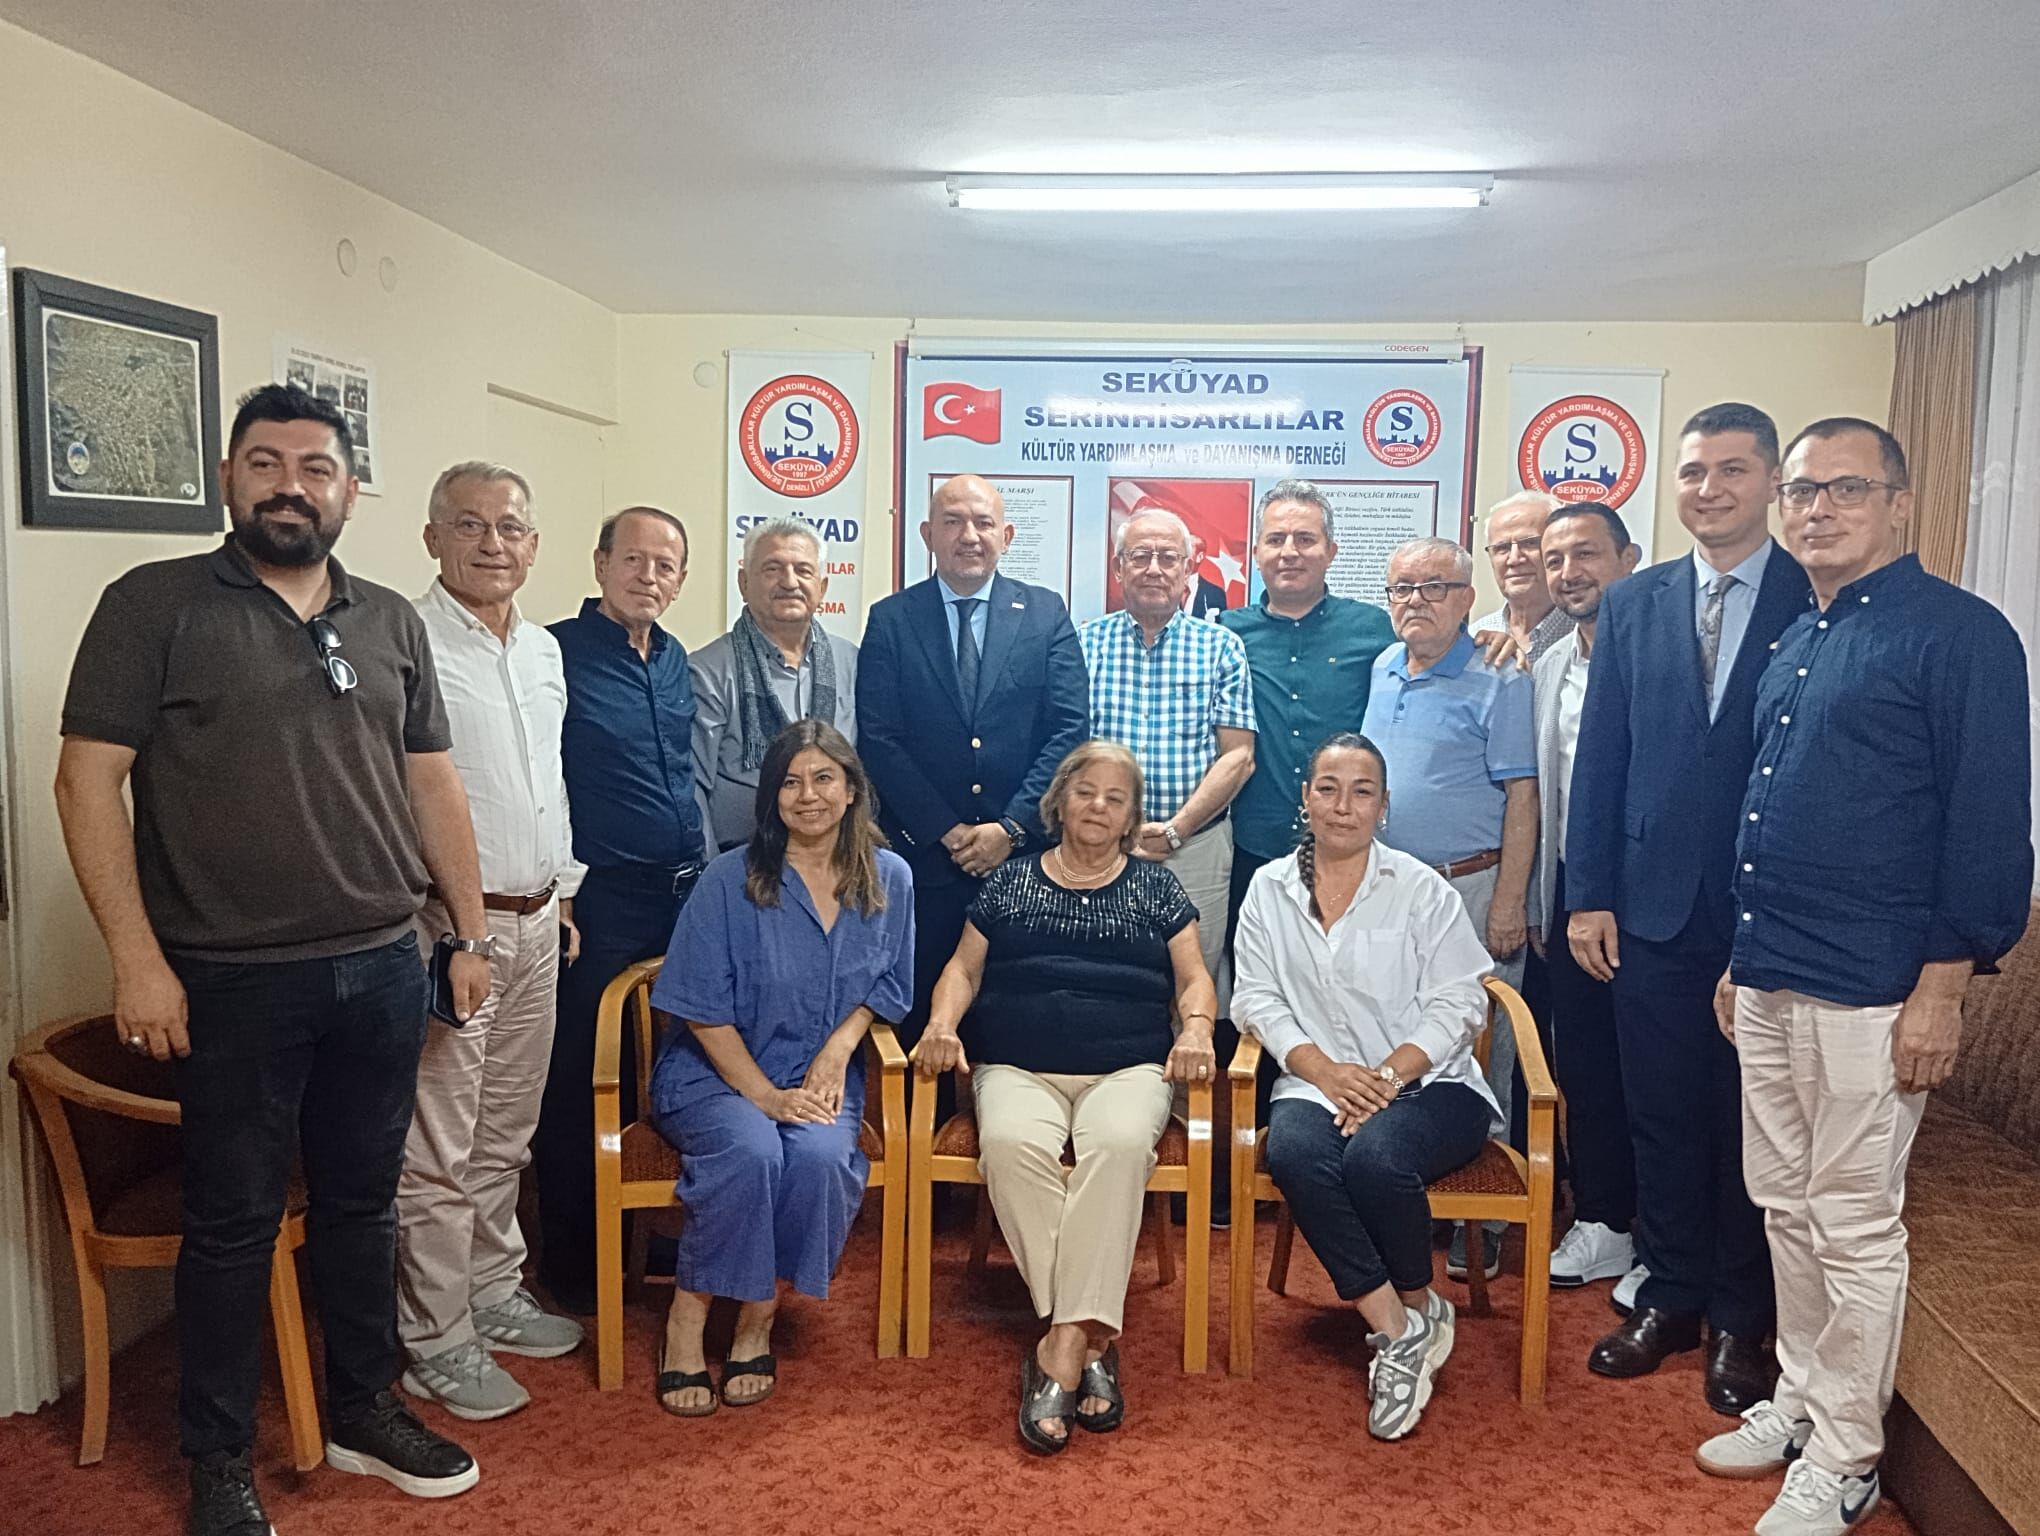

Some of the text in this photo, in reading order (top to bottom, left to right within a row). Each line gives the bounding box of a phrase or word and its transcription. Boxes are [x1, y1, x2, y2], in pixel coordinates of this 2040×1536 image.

[775, 383, 832, 402] YARDIMLAŞMA
[1102, 369, 1269, 394] SEKÜYAD
[751, 391, 775, 418] KÜLTÜR
[832, 400, 842, 412] VE
[1024, 402, 1344, 431] SERİNHİSARLILAR
[784, 402, 814, 441] S
[1391, 406, 1413, 431] S
[839, 411, 852, 459] DAYANIŞMA
[1531, 412, 1558, 442] KÜLTÜR
[1558, 403, 1618, 422] YARDIMLAŞMA
[1618, 420, 1629, 432] VE
[1624, 431, 1638, 479] DAYANIŞMA
[1565, 423, 1597, 463] S
[1021, 437, 1346, 469] KÜLTÜR YARDIMLAŞMA ve DAYANIŞMA DERNEĞİ
[777, 462, 822, 472] SEKÜYAD
[815, 460, 846, 488] DERNEĞİ
[1556, 485, 1604, 494] SEKÜYAD
